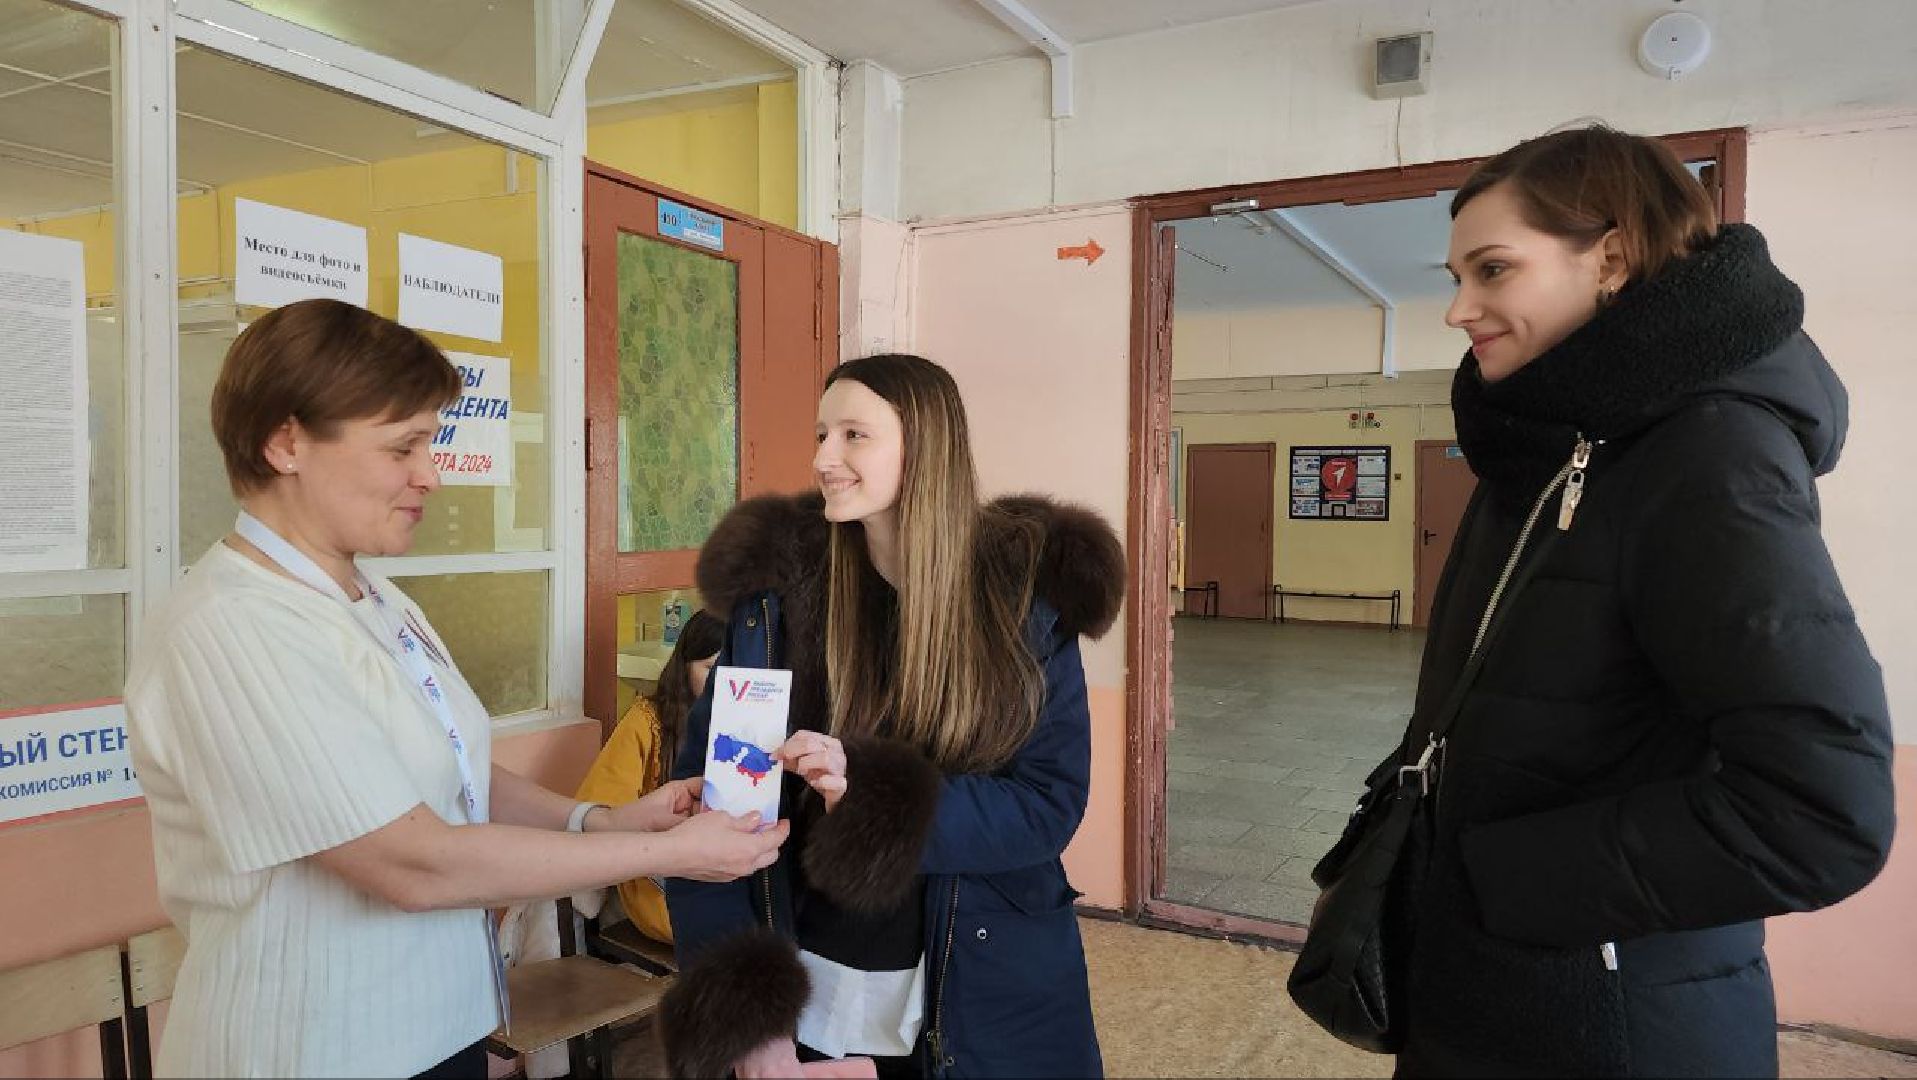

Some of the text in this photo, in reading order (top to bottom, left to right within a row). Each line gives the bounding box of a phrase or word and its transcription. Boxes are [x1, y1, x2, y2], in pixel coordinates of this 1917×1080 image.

[244, 236, 361, 273] Место для фото и
[261, 265, 347, 290] видеосъёмки
[404, 273, 500, 305] НАБЛЮДАТЕЛИ
[458, 454, 492, 473] 2024
[124, 767, 137, 781] 1
